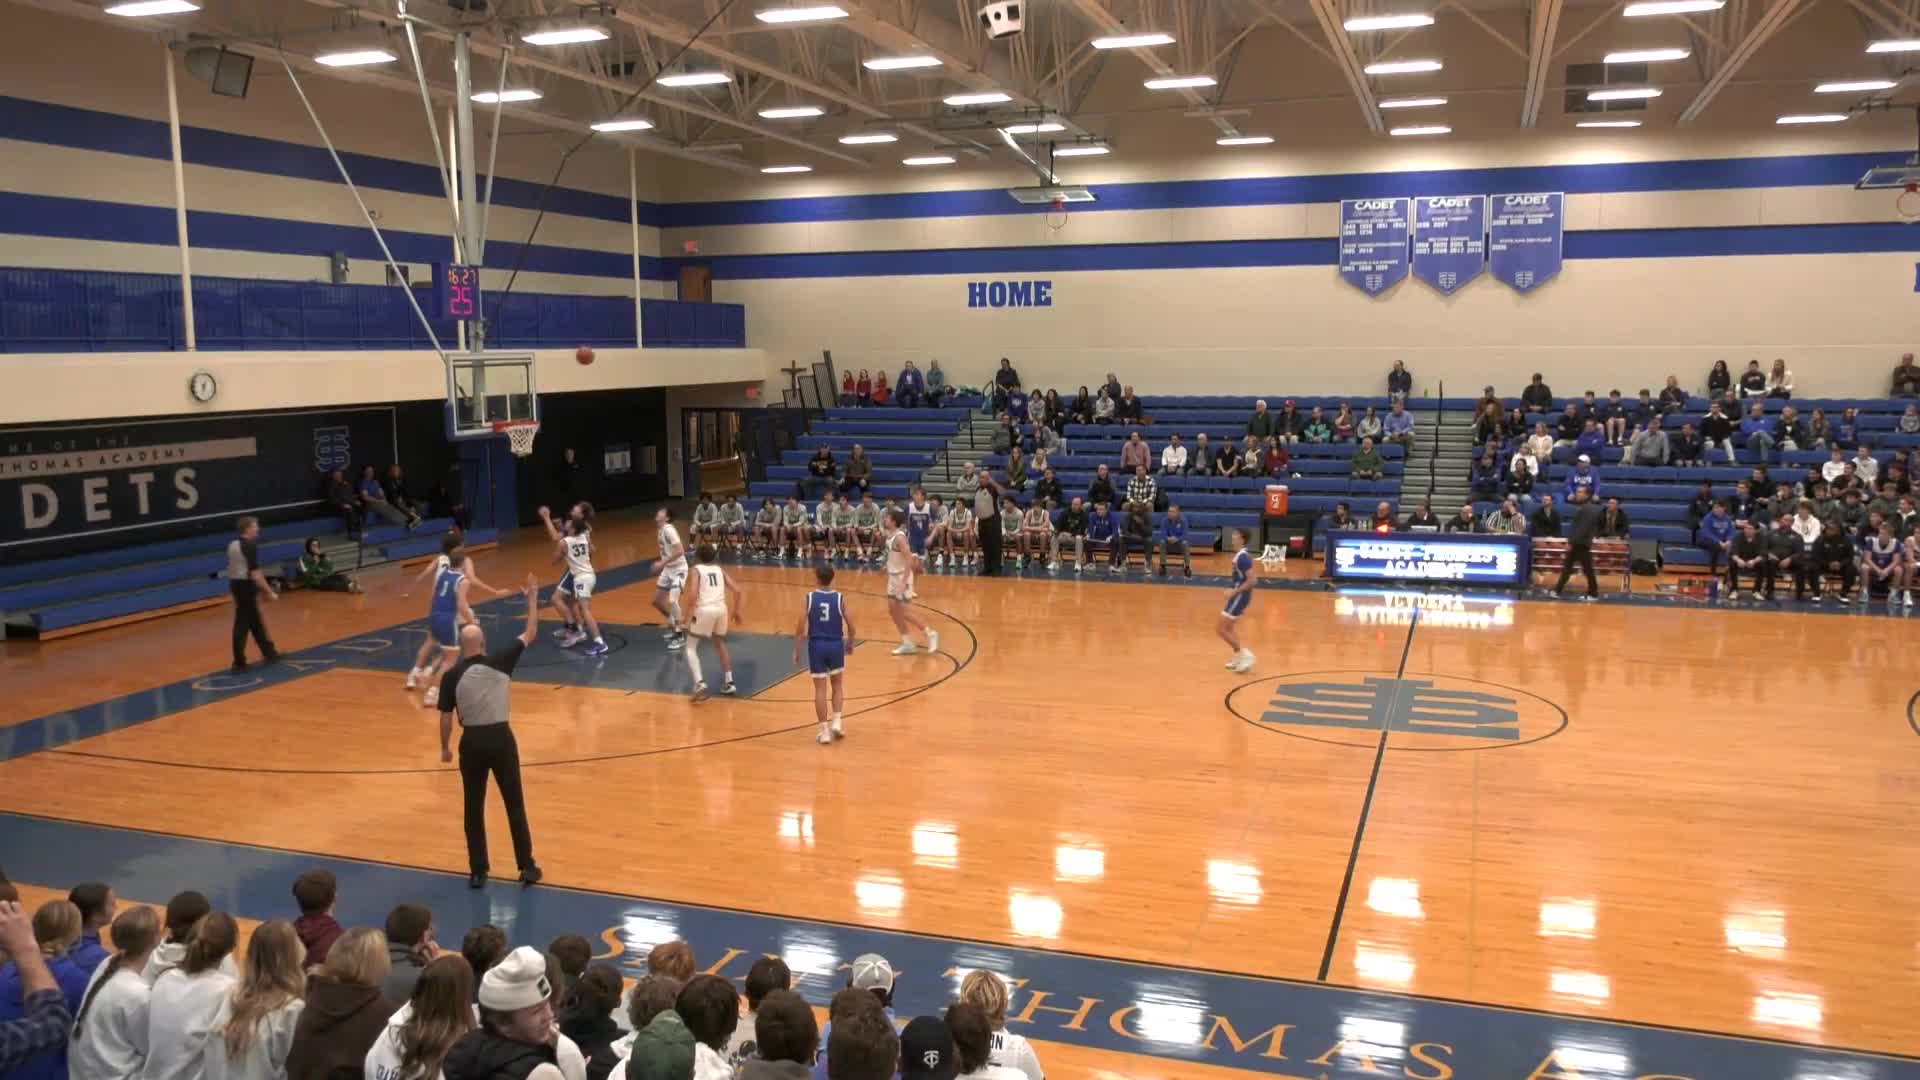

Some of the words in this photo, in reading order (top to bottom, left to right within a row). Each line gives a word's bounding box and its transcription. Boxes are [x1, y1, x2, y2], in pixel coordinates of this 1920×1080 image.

[1354, 201, 1396, 210] CADET
[1429, 198, 1471, 208] CADET
[1505, 195, 1549, 205] CADET
[450, 287, 472, 314] 25
[967, 281, 1052, 307] HOME
[100, 448, 185, 464] ACADEMY
[21, 468, 199, 529] DETS
[572, 543, 586, 557] 33
[819, 602, 830, 621] 3
[943, 966, 1455, 1080] HOMAS
